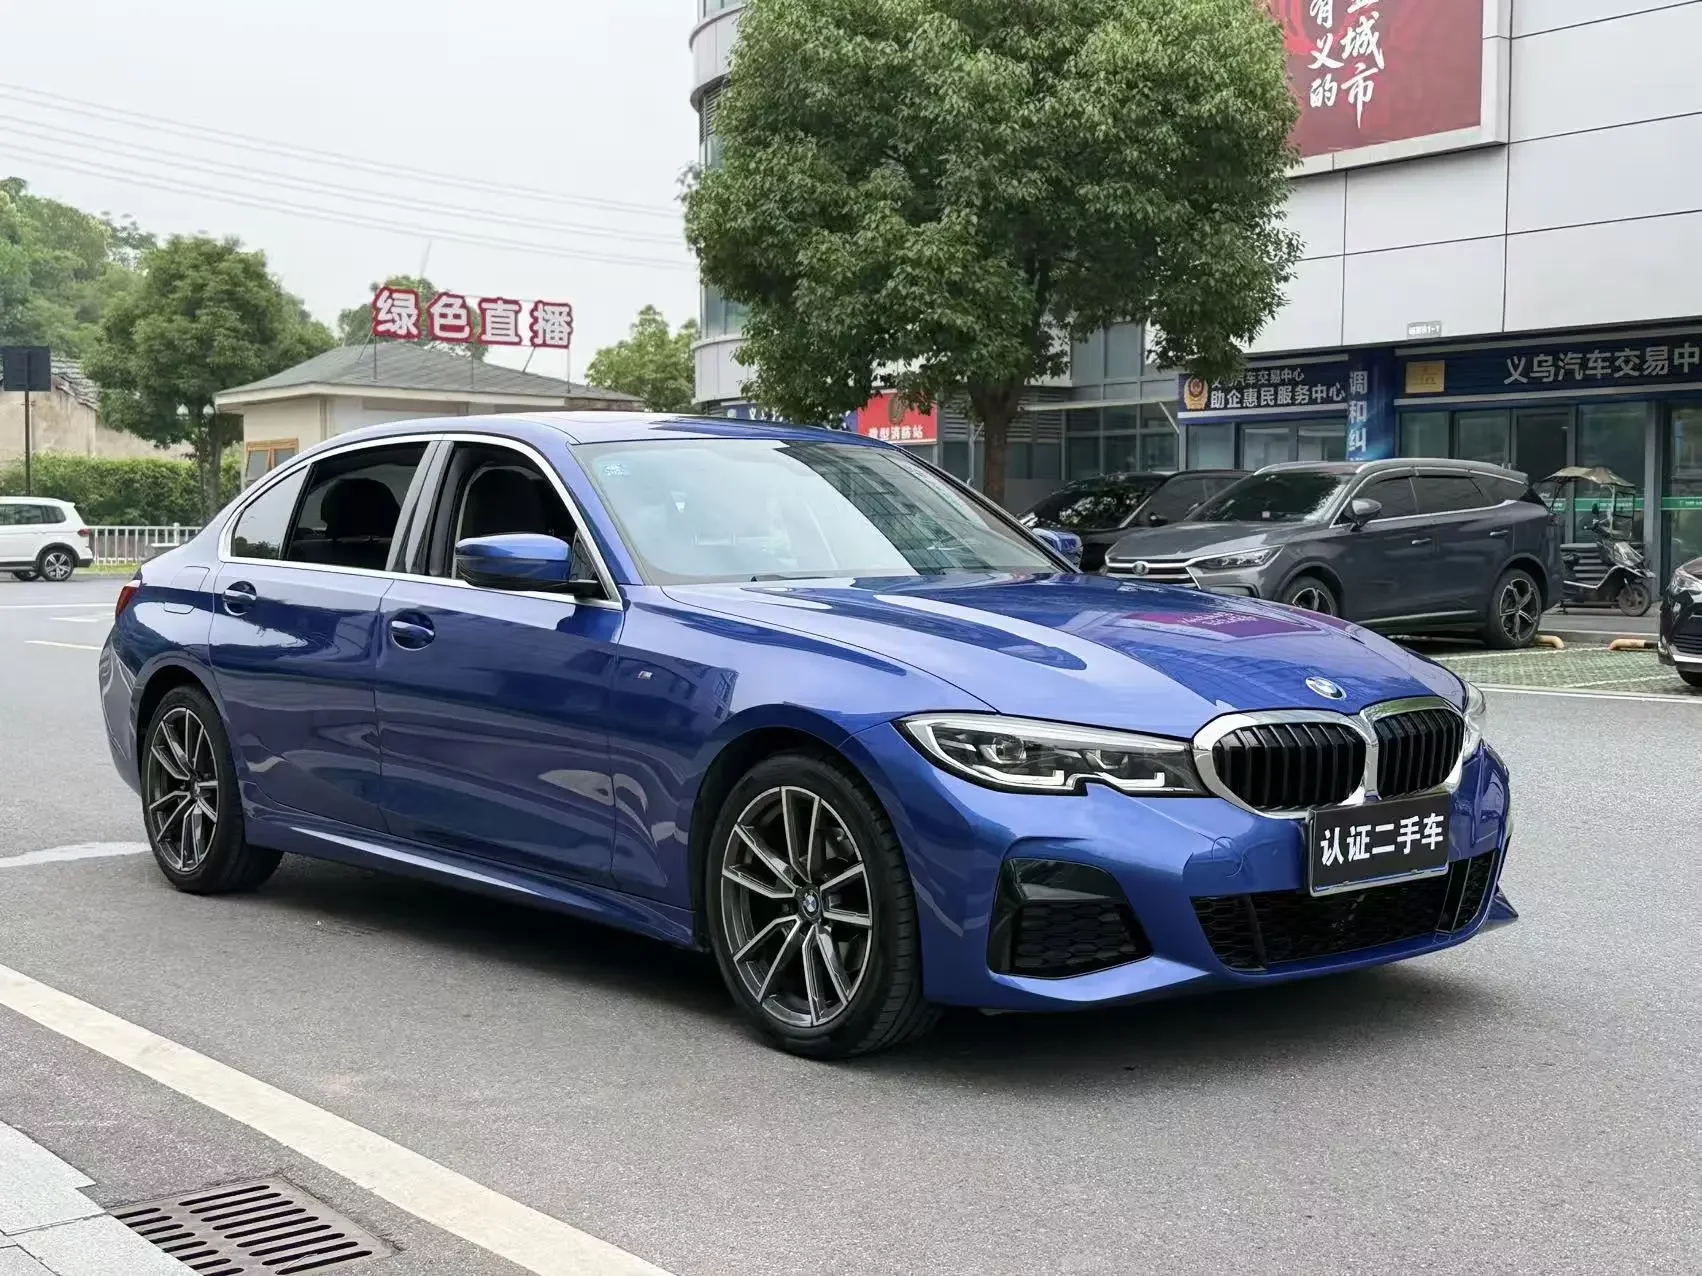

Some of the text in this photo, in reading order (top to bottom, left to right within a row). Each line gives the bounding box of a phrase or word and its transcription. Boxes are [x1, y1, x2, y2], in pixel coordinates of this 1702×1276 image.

[374, 287, 573, 348] 绿色直播
[1503, 342, 1700, 385] 义乌汽车交易中
[1210, 382, 1346, 409] 助企惠民服务中心
[1348, 370, 1368, 461] 调和纠
[1320, 812, 1444, 867] 认证二手车
